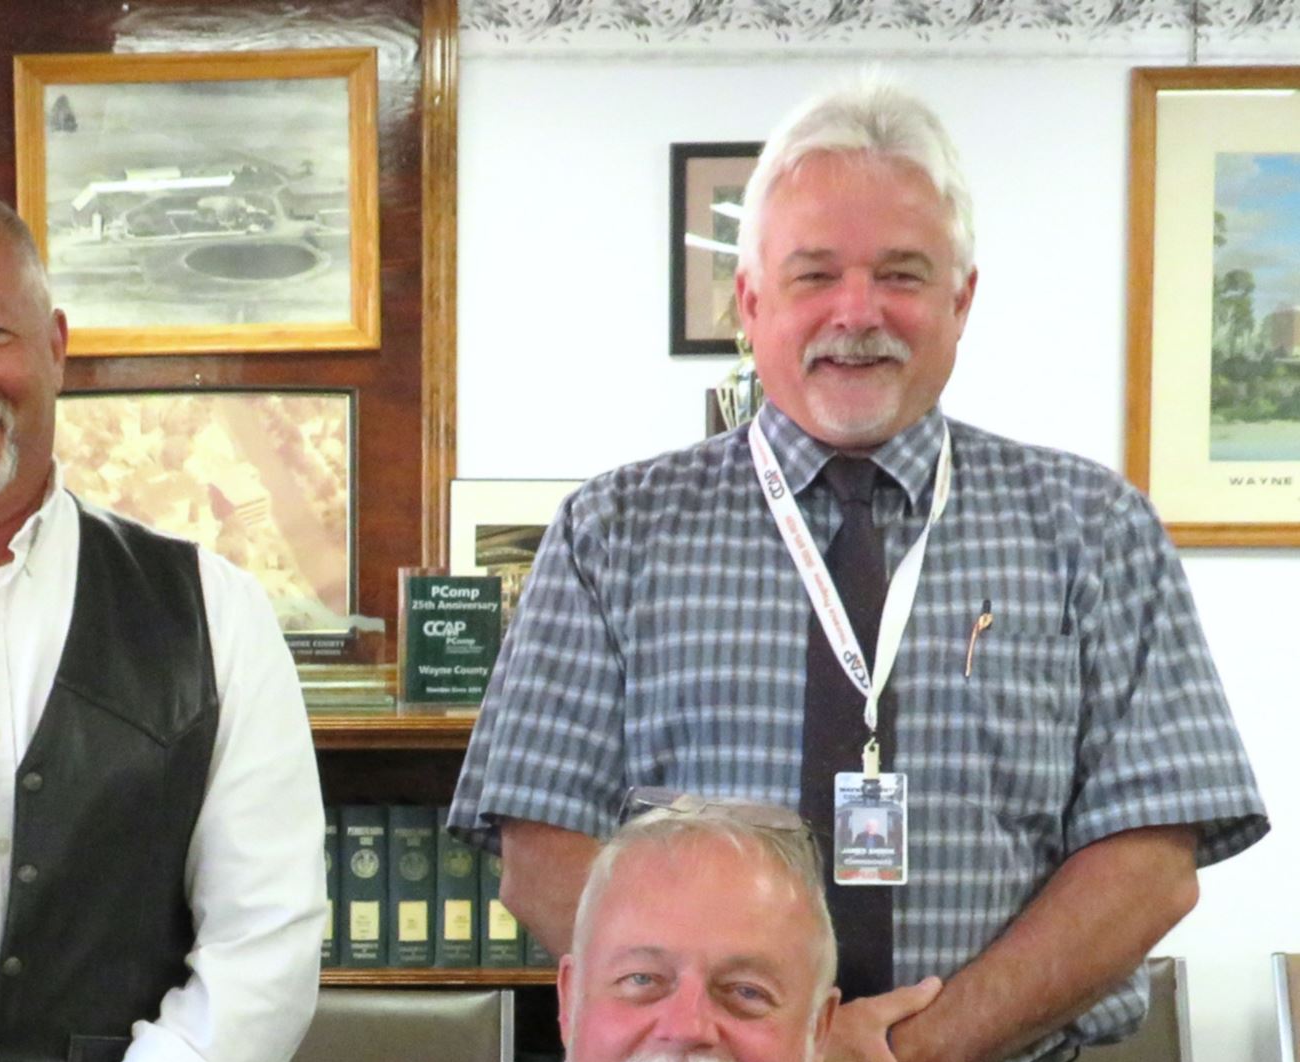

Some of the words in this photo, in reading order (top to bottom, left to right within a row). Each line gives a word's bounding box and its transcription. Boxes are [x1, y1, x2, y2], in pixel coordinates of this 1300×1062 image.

[761, 468, 787, 501] CCAP
[1229, 476, 1292, 486] WAYNE
[431, 585, 480, 600] PComp
[412, 600, 435, 610] 25th
[437, 600, 498, 612] Anniversary
[423, 621, 467, 637] CCAP
[446, 637, 476, 646] PComp
[418, 665, 452, 676] Wayne
[454, 665, 488, 676] County
